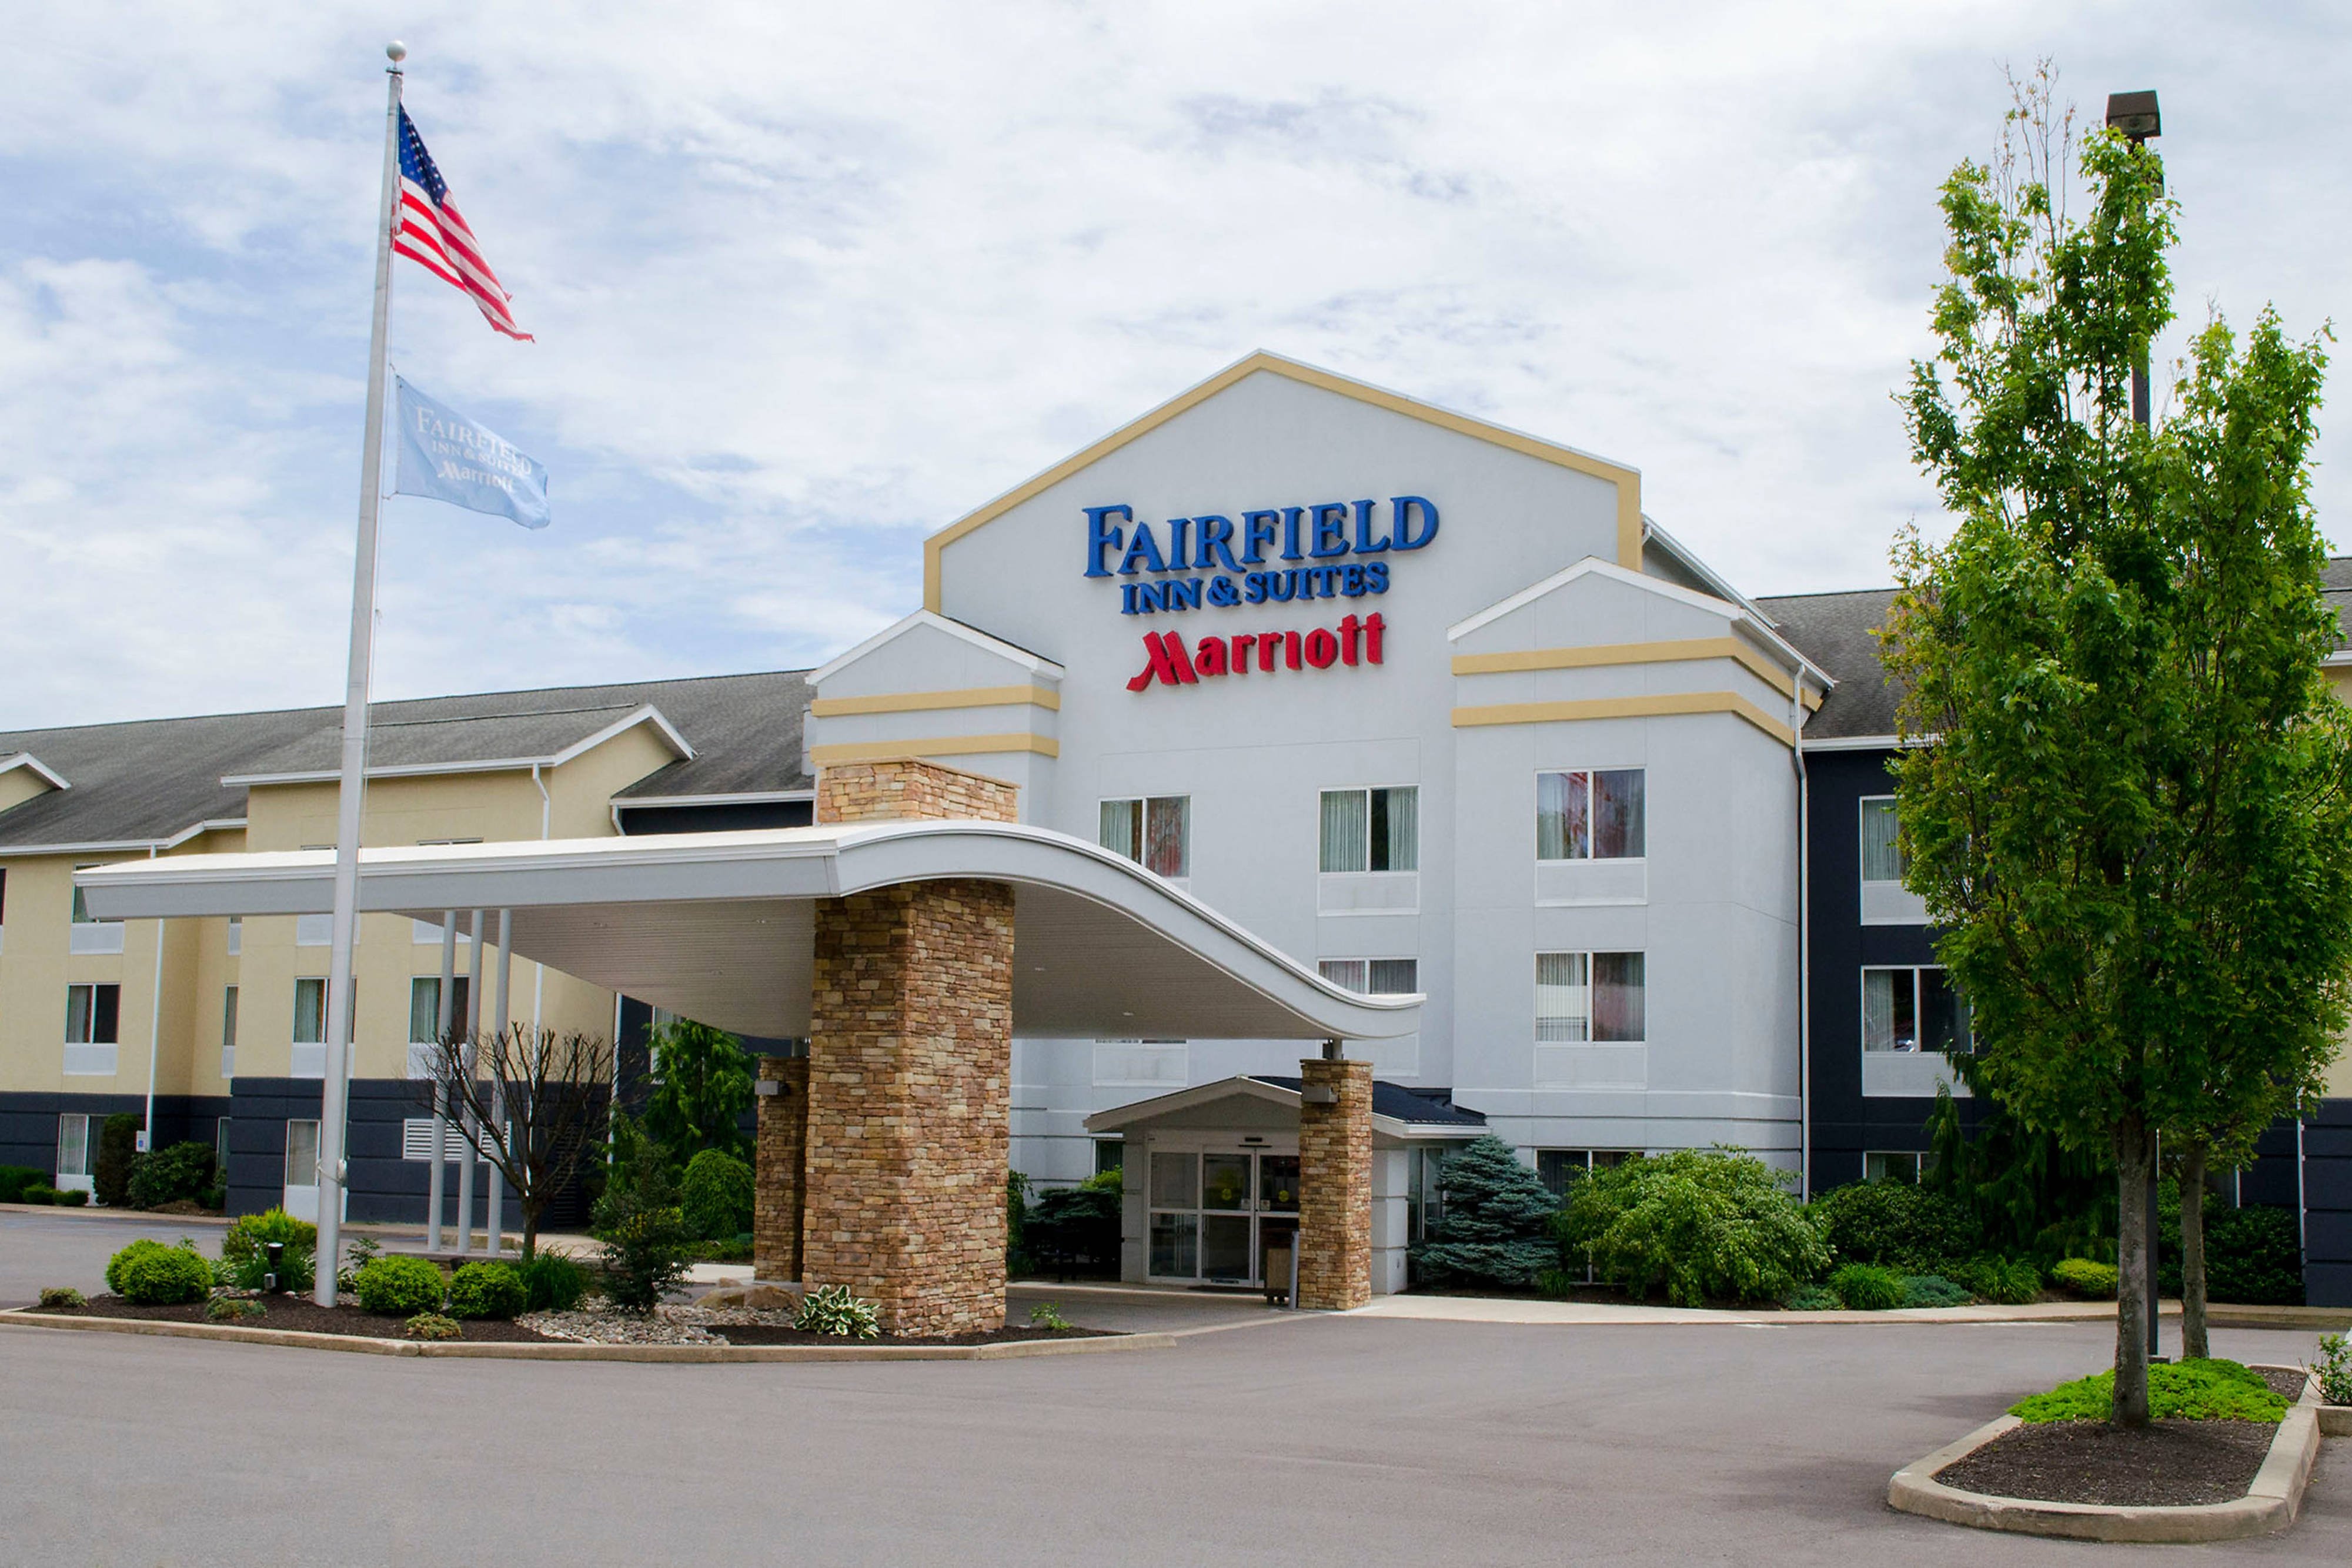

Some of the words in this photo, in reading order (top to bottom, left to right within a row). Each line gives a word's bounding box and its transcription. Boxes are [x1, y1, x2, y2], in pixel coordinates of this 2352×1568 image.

[437, 459, 514, 493] Marriott
[1081, 495, 1440, 577] FAIRFIELD
[1120, 577, 1203, 614] INN
[1205, 574, 1241, 607] &
[1244, 561, 1390, 604] SUITES
[1125, 611, 1387, 692] Marriott
